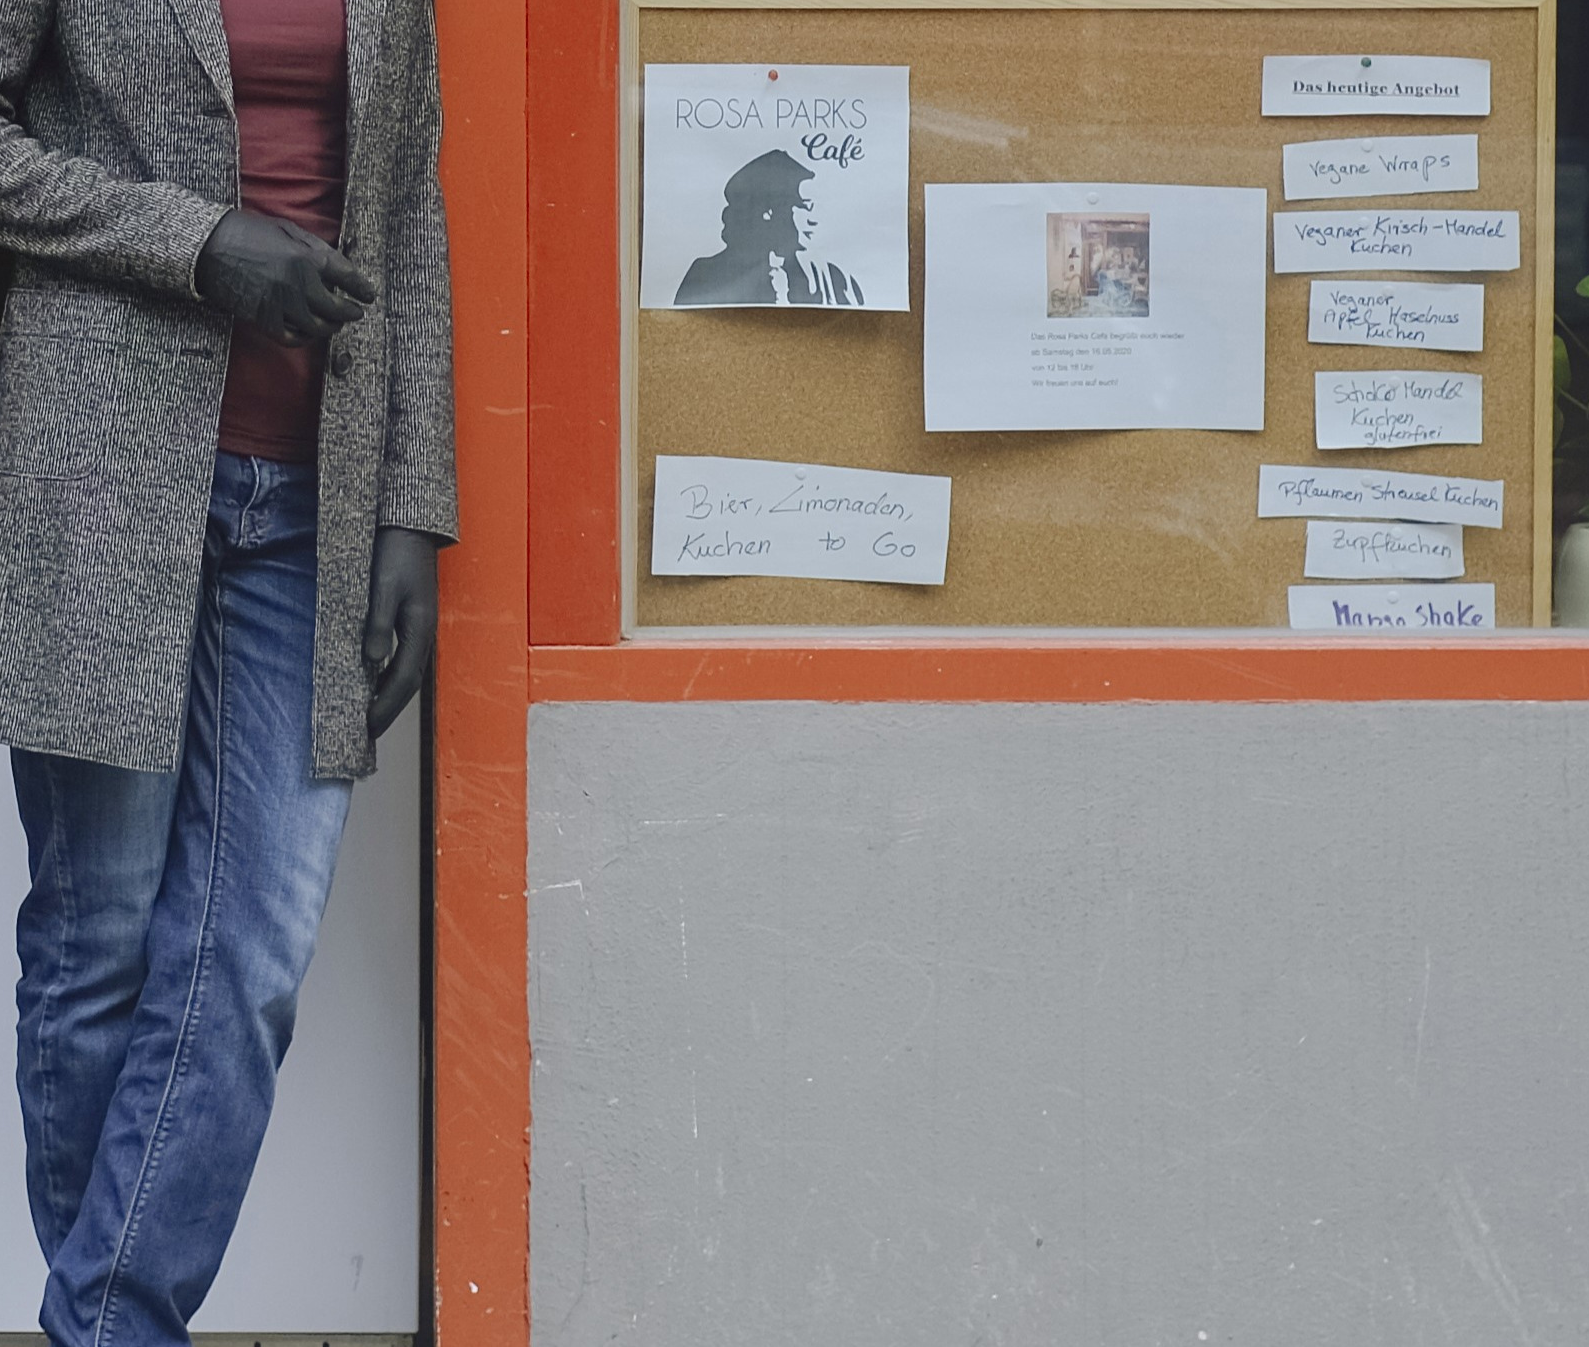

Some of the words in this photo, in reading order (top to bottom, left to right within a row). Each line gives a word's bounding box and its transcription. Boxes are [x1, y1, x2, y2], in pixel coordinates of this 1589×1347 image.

[1293, 80, 1323, 95] Das
[1327, 80, 1388, 97] heutige
[1392, 82, 1460, 98] Angebot
[676, 98, 763, 129] ROSA
[776, 98, 867, 129] PARKS
[801, 133, 865, 169] Café
[1295, 223, 1365, 246] Veganer
[1350, 236, 1412, 256] Kuchen
[1330, 290, 1394, 311] Veganer
[1388, 305, 1460, 326] Haselnuss
[1351, 407, 1413, 427] Kuchen
[1364, 424, 1443, 446] glutenfrei
[680, 484, 762, 520] Bier,
[768, 485, 913, 522] Limonaden,
[1278, 478, 1364, 506] Pflaumen
[1444, 483, 1498, 511] Kuchen
[676, 530, 771, 562] Kuchen
[818, 531, 846, 551] to
[872, 531, 916, 558] Go
